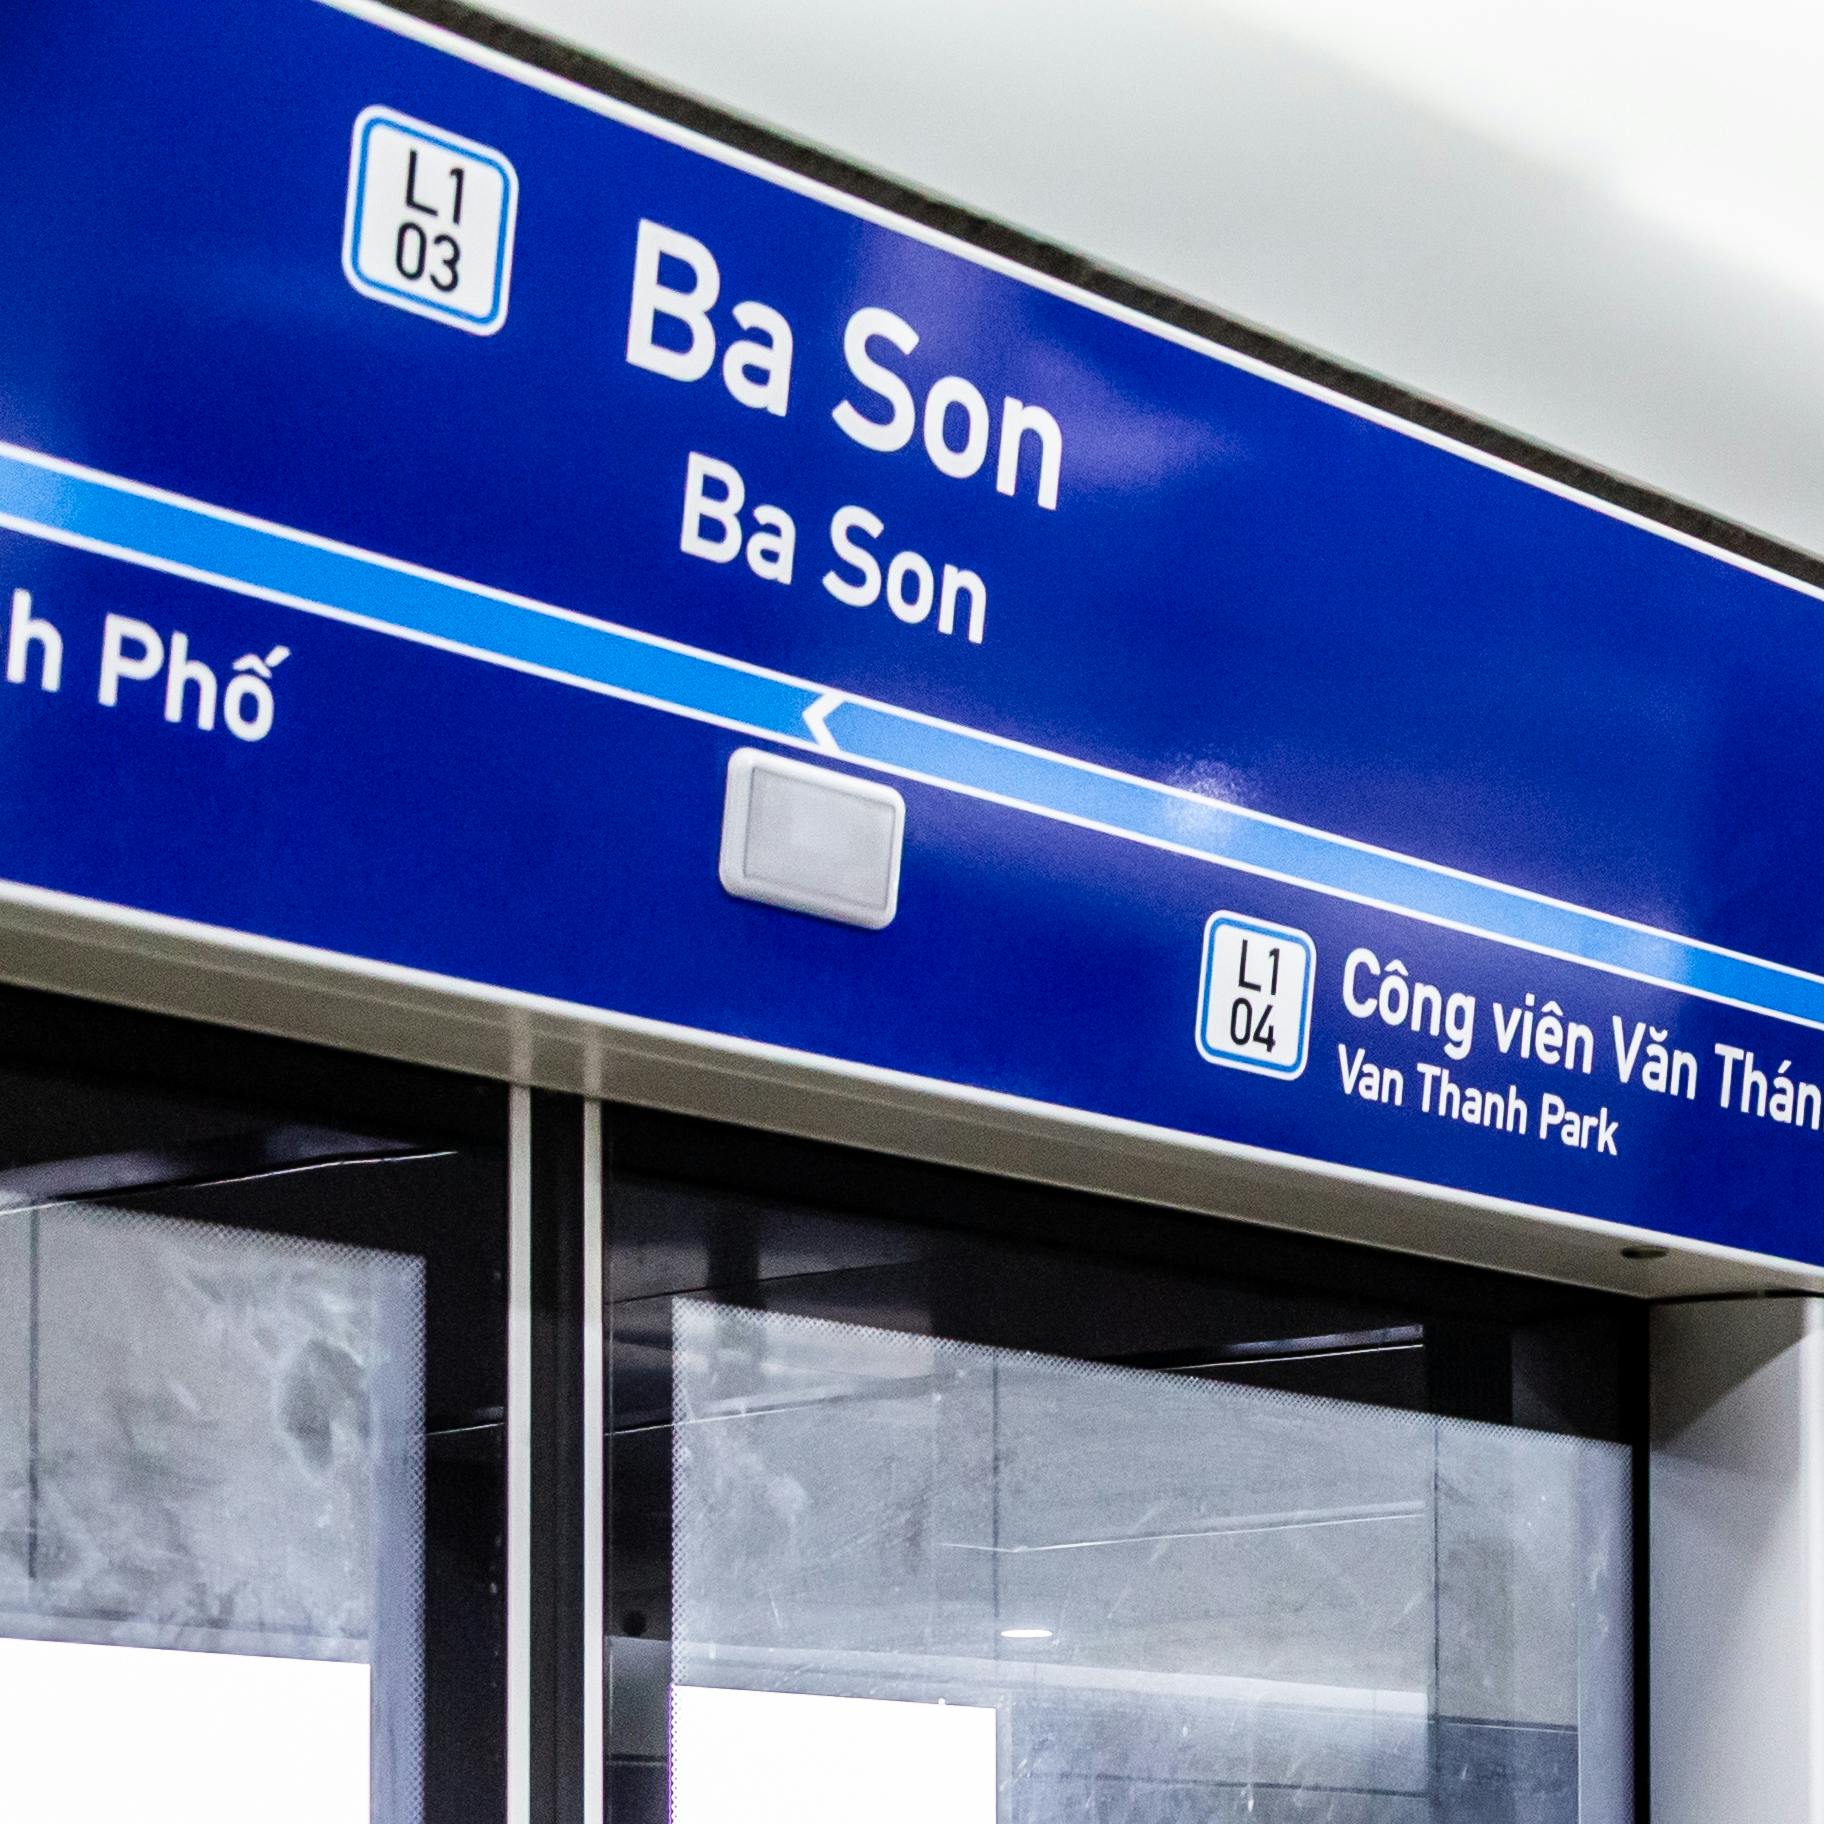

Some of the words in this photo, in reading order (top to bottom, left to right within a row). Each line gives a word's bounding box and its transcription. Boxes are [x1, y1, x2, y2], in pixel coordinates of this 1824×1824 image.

[405, 148, 464, 225] L1
[395, 221, 461, 293] 03
[626, 218, 794, 418] Ba
[831, 307, 1063, 511] Son
[679, 451, 796, 585] Ba
[822, 505, 987, 645] Son
[98, 612, 293, 742] Phố
[1238, 939, 1280, 996] L1
[1342, 947, 1476, 1060] Công
[1492, 992, 1594, 1074] viên
[1612, 1015, 1698, 1100] Văn
[1230, 997, 1276, 1053] 04
[1338, 1043, 1404, 1106] Van
[1416, 1062, 1528, 1135] Thanh
[1539, 1092, 1620, 1156] Park
